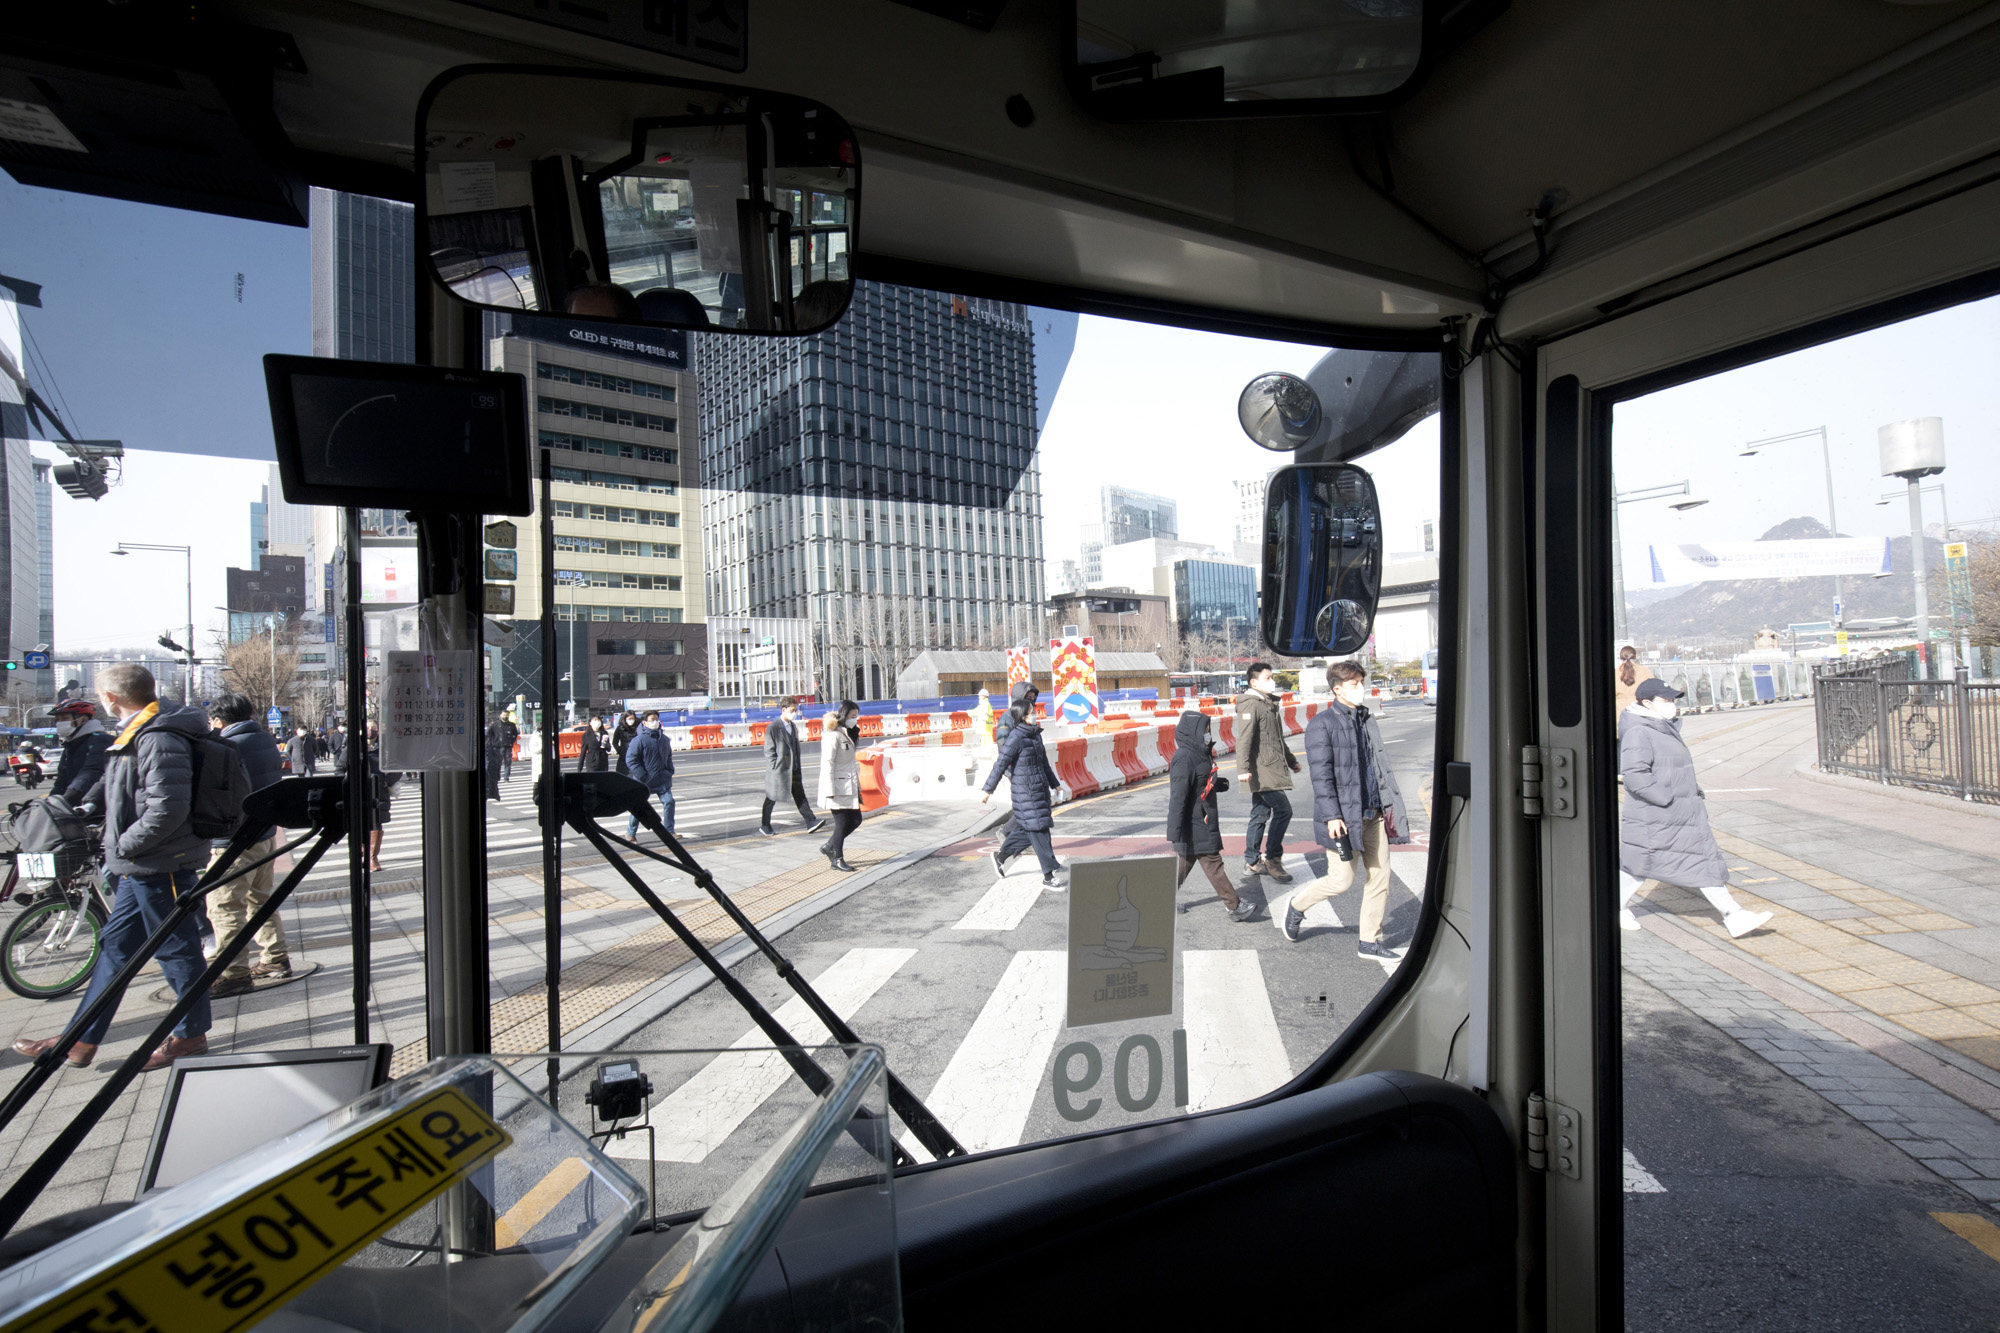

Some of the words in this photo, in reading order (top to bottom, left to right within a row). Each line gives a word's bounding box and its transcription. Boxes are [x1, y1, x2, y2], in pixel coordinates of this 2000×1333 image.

[569, 328, 599, 344] QLED
[599, 335, 609, 346] 로
[610, 337, 636, 351] 구현한
[458, 673, 464, 682] 2
[395, 687, 400, 696] 3
[405, 687, 411, 696] 4
[416, 687, 422, 696] 5
[447, 687, 453, 696] 8
[458, 687, 464, 696] 9
[394, 700, 402, 709] 10
[404, 700, 412, 709] 11
[414, 700, 422, 709] 12
[426, 700, 434, 709] 13
[436, 700, 444, 709] 14
[446, 700, 454, 709] 15
[456, 700, 465, 709] 16
[394, 713, 402, 722] 17
[404, 713, 412, 722] 18
[415, 713, 422, 722] 19
[424, 713, 433, 722] 20
[435, 713, 443, 722] 21
[446, 713, 454, 722] 22
[456, 713, 464, 722] 23
[404, 726, 412, 736] 25
[414, 726, 422, 736] 26
[424, 726, 433, 736] 27
[436, 726, 444, 736] 28
[446, 726, 454, 736] 29
[456, 726, 464, 736] 30
[165, 1194, 334, 1310] 넣어
[315, 1110, 496, 1214] 주세요.
